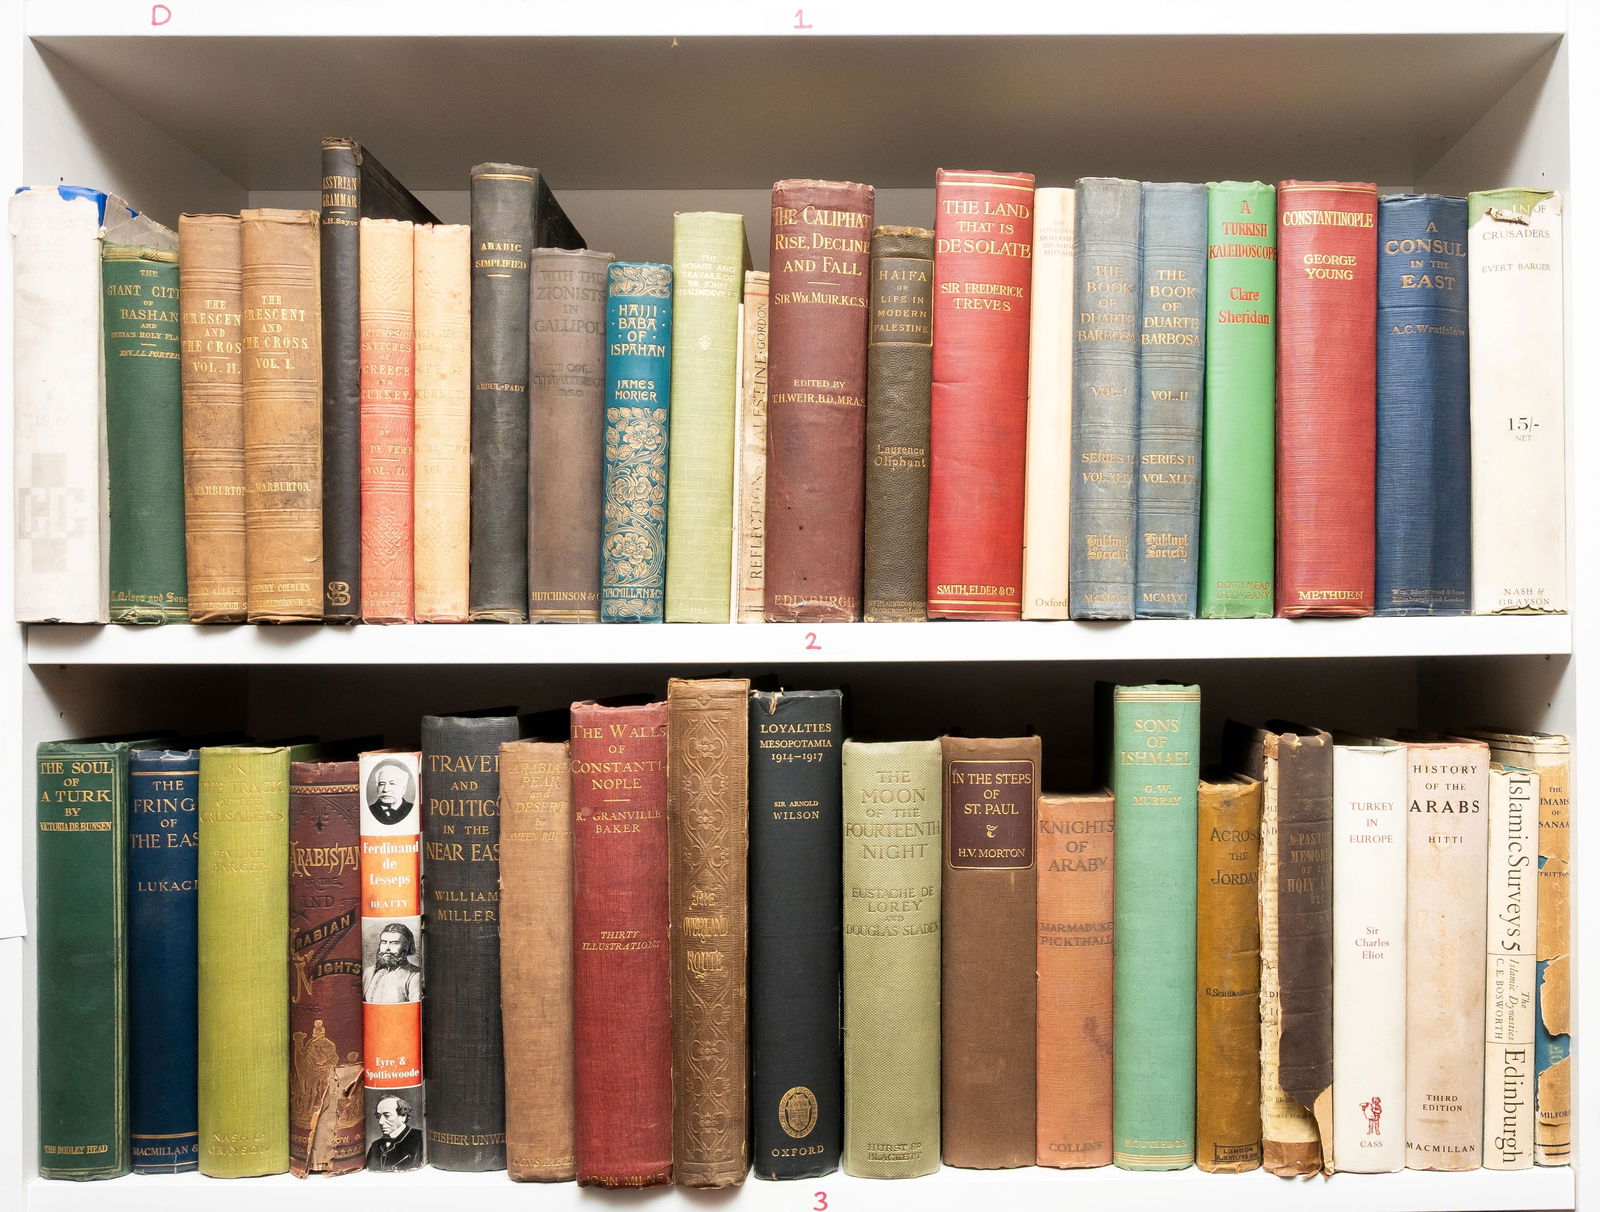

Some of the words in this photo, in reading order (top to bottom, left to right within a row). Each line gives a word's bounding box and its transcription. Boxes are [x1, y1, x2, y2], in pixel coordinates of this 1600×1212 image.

[152, 4, 171, 26] D
[794, 9, 811, 28] 1
[943, 200, 979, 214] THE
[984, 201, 1030, 219] LAND
[1241, 201, 1251, 214] A
[1283, 210, 1373, 228] CONSTANTINOPLE
[957, 221, 994, 233] THAT
[999, 224, 1014, 235] IS
[1222, 222, 1268, 237] TURKISH
[1425, 221, 1438, 233] A
[1483, 229, 1550, 241] CRUSADERS
[481, 241, 522, 252] ARABIC
[937, 239, 1031, 258] DESOLATE
[1384, 239, 1466, 257] CONSUL
[475, 259, 527, 269] SIMPLIFIED
[1303, 254, 1356, 266] GEORGE
[1410, 260, 1423, 268] IN
[1429, 260, 1450, 269] THE
[783, 260, 815, 272] AND
[823, 257, 862, 276] FALL
[1482, 263, 1513, 273] EVERT
[1518, 262, 1551, 271] BARGER
[879, 271, 927, 281] HAIFA
[1157, 270, 1186, 280] THE
[1305, 268, 1353, 280] YOUNG
[1401, 274, 1456, 290] EAST
[106, 285, 141, 296] GIANT
[941, 282, 960, 294] SIR
[965, 282, 1024, 298] FREDERICK
[1150, 285, 1197, 298] BOOK
[1230, 287, 1260, 301] Clare
[205, 300, 225, 309] THE
[262, 295, 282, 304] THE
[775, 294, 789, 304] SIR
[913, 296, 924, 304] IN
[953, 298, 1011, 312] TREVES
[619, 304, 657, 318] HAJJI
[1162, 302, 1180, 311] OF
[120, 309, 178, 322] BASHAN
[878, 310, 927, 318] MODERN
[1218, 309, 1270, 325] Sheridan
[261, 324, 282, 332] AND
[618, 318, 656, 330] BABA
[758, 303, 766, 350] GORDON
[873, 324, 928, 334] PALESTINE
[204, 328, 225, 337] AND
[627, 330, 647, 342] OF
[611, 344, 665, 357] ISPAHAN
[617, 380, 654, 389] JAMES
[794, 380, 829, 388] EDITED
[833, 381, 846, 389] BY
[615, 391, 657, 403] MORIER
[1507, 416, 1539, 433] 15/-
[1142, 454, 1184, 464] SERIES
[532, 592, 586, 601] HUTCHINSON
[1298, 591, 1364, 600] METHUEN
[1504, 588, 1534, 596] NASH
[1035, 598, 1067, 608] Oxford
[805, 632, 821, 650] 2
[572, 725, 602, 739] THE
[760, 723, 832, 733] LOYALTIES
[1134, 719, 1180, 733] SONS
[760, 739, 832, 748] MESOPOTAMIA
[1145, 736, 1168, 748] OF
[609, 745, 625, 753] OF
[1120, 751, 1191, 765] ISHMAEL
[39, 762, 63, 774] THE
[72, 762, 113, 774] SOUL
[1413, 765, 1478, 774] HISTORY
[64, 779, 79, 787] OF
[876, 771, 911, 783] THE
[952, 774, 964, 784] IN
[969, 774, 993, 785] THE
[996, 773, 1031, 784] STEPS
[153, 781, 183, 790] THE
[450, 781, 478, 790] AND
[592, 779, 642, 790] NOPLE
[1425, 783, 1439, 791] OF
[1446, 783, 1467, 791] THE
[41, 791, 50, 802] A
[56, 790, 112, 802] TURK
[862, 788, 926, 804] MOON
[983, 790, 1000, 800] OF
[64, 808, 81, 816] BY
[964, 804, 982, 815] ST.
[985, 804, 1019, 815] PAUL
[1350, 802, 1394, 811] TURKEY
[1409, 800, 1480, 814] ARABS
[576, 812, 586, 821] R.
[593, 811, 661, 821] GRANVILLE
[773, 811, 820, 820] WILSON
[865, 809, 882, 818] OF
[893, 808, 920, 817] THE
[1508, 777, 1531, 853] Islamic
[81, 822, 112, 831] BUNSEN
[160, 819, 177, 827] OF
[595, 824, 640, 833] BAKER
[1039, 820, 1114, 834] KNIGHTS
[1366, 818, 1378, 827] IN
[443, 826, 454, 835] IN
[464, 826, 489, 835] THE
[845, 821, 941, 838] FOURTEENTH
[130, 833, 160, 848] THE
[1350, 835, 1393, 844] EUROPE
[1428, 836, 1463, 844] HITTI
[363, 841, 419, 854] Ferdinand
[427, 843, 464, 861] NEAR
[863, 843, 928, 860] NIGHT
[978, 848, 1025, 858] MORTON
[1066, 841, 1089, 853] OF
[1229, 852, 1248, 861] THE
[383, 858, 397, 869] de
[1048, 857, 1108, 872] ARABY
[370, 874, 411, 888] Lesseps
[851, 887, 916, 898] EUSTACHE
[921, 886, 934, 897] DE
[1499, 855, 1530, 937] Surveys
[371, 900, 409, 908] BEATTY
[868, 900, 922, 913] LOREY
[437, 910, 496, 922] MILLER
[600, 931, 639, 939] THIRTY
[1366, 926, 1379, 935] Sir
[582, 941, 660, 950] ILLUSTRATIONS
[1355, 938, 1389, 948] Charles
[1501, 940, 1521, 952] 5
[1362, 951, 1384, 960] Eliot
[1508, 957, 1520, 993] Islamic
[1520, 991, 1530, 1009] The
[1494, 979, 1504, 1040] BOSWORTH
[1504, 994, 1519, 1042] Dynasties
[365, 1070, 420, 1080] Spottiswoode
[1426, 1094, 1458, 1102] THIRD
[1422, 1103, 1462, 1112] EDITION
[1494, 1048, 1526, 1164] Edinburgh
[86, 1144, 108, 1153] HEAD
[1360, 1140, 1383, 1148] CASS
[1406, 1141, 1475, 1153] MACMILLAN
[134, 1146, 188, 1156] MACMILLAN
[772, 1145, 824, 1157] OXFORD
[813, 1191, 829, 1212] 3
